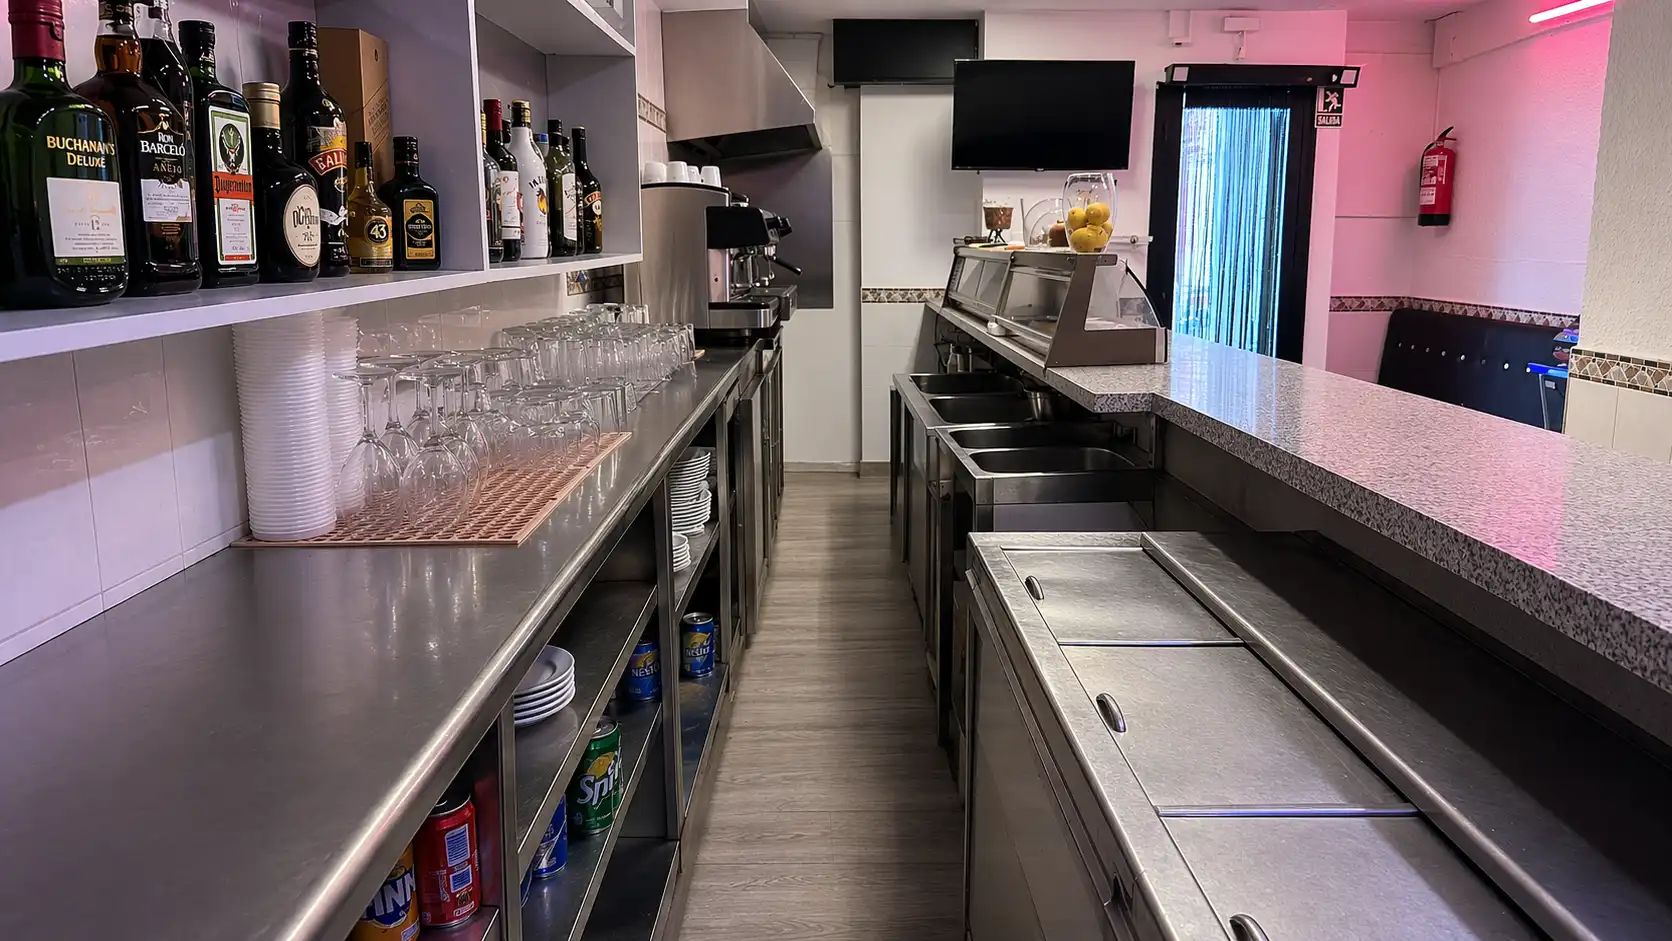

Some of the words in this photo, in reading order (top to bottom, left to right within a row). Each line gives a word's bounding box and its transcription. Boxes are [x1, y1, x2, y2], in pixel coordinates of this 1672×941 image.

[46, 135, 116, 156] BUCHANAN'S
[140, 140, 186, 157] BARCELÓ
[66, 152, 106, 168] DELUXE
[370, 223, 387, 239] 43
